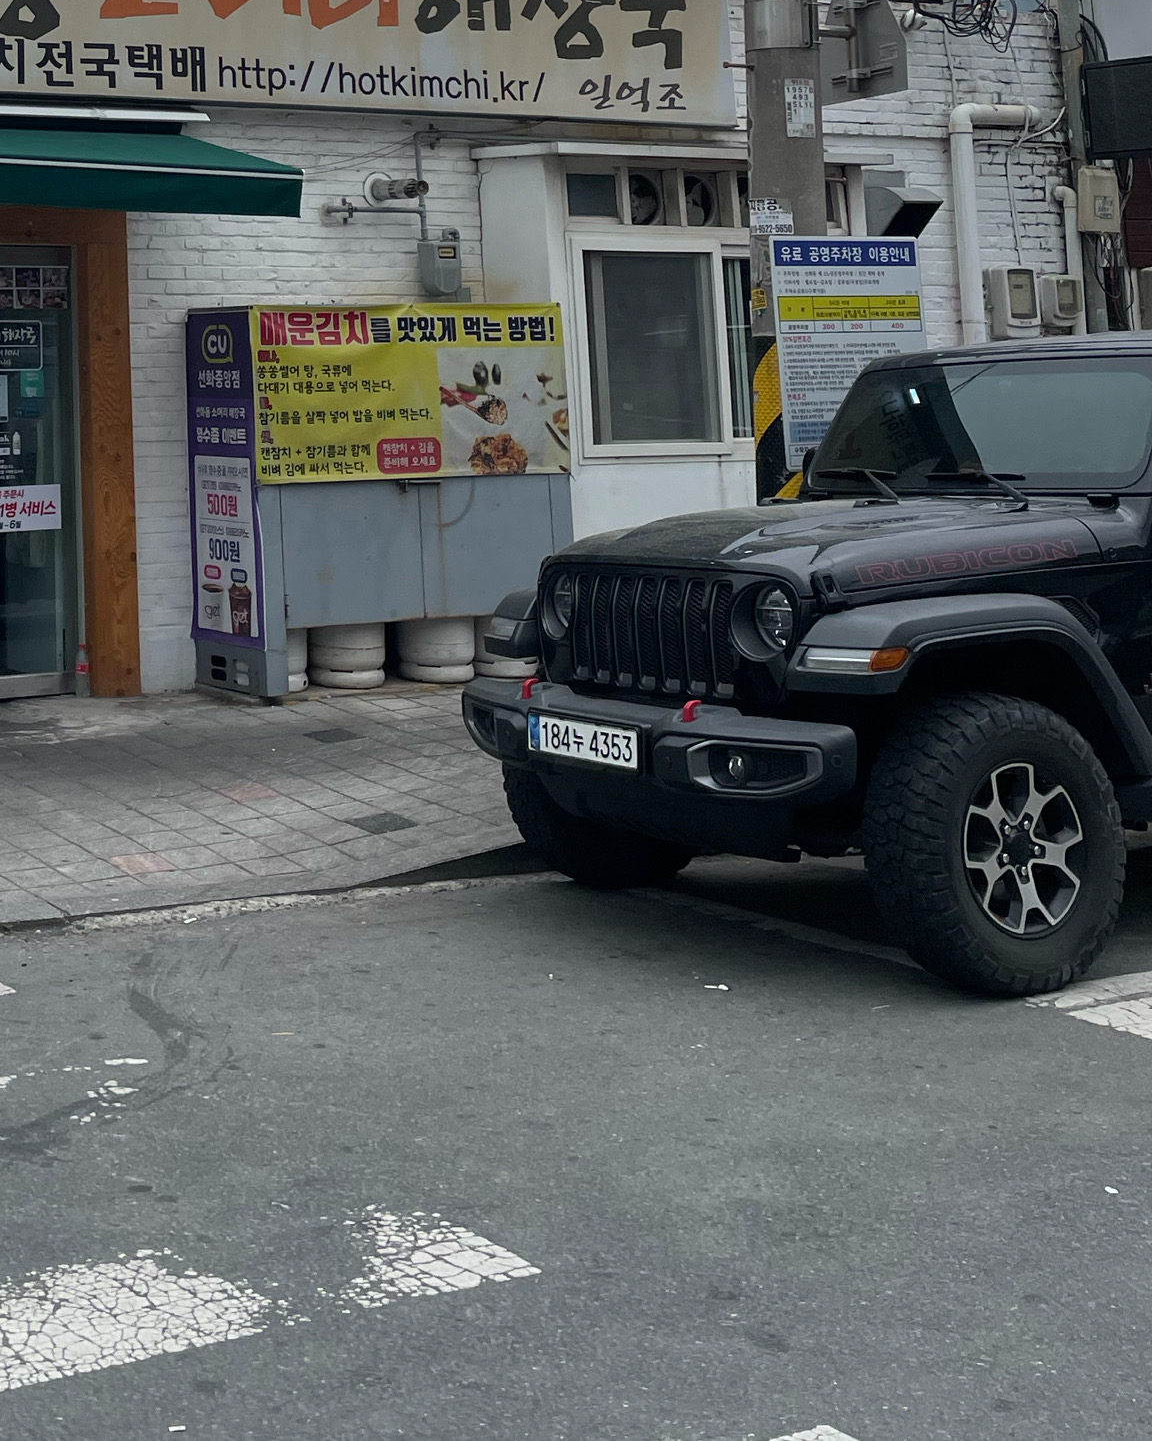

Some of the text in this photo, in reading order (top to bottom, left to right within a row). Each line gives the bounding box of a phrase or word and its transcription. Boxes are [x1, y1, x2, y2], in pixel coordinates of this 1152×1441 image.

[218, 56, 545, 103] http://hotkimchi.kr/
[579, 74, 686, 113] 일억조
[780, 246, 910, 263] 유료 공영주차장 이용안내
[259, 311, 556, 346] 매운김치를 맛있게 먹는 방법!
[822, 323, 836, 331] 300
[207, 334, 227, 354] CU
[198, 369, 241, 389] 선화중앙점
[304, 364, 318, 379] 탕,
[321, 364, 352, 377] 국류에
[258, 379, 396, 395] 다대기 대용으로 넣어 먹는다.
[258, 407, 434, 426] 참기름을 살짝 넣어 밥을 비벼 먹는다.
[260, 444, 371, 461] 캔참치 + 참기름과 함께
[261, 461, 369, 477] 비벼 김에 싸서 먹는다.
[19, 500, 57, 517] 서비스
[207, 493, 238, 517] 500원
[209, 538, 240, 563] 900원
[856, 539, 1079, 586] RUBICON
[204, 605, 249, 625] get get
[542, 721, 633, 763] 184누 4353
